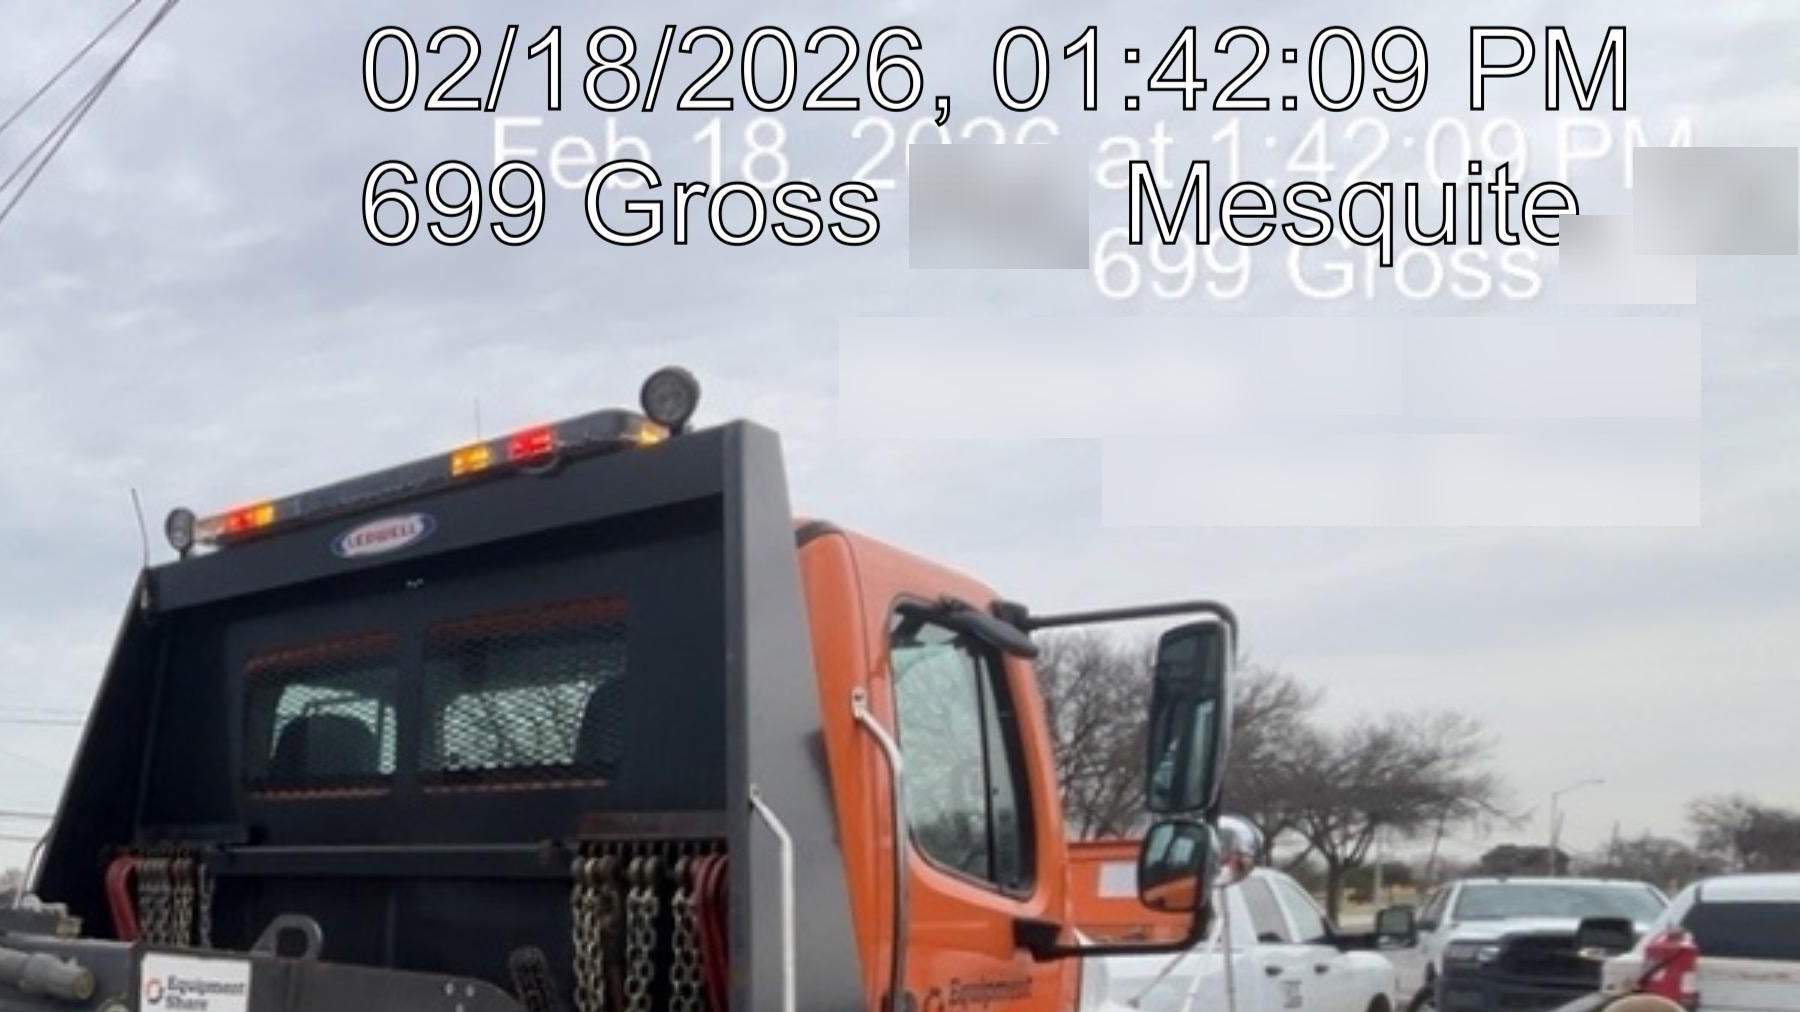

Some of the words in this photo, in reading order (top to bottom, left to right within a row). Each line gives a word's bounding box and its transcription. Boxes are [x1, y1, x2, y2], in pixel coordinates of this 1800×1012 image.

[347, 520, 416, 549] LEDWELL
[167, 974, 245, 996] Equipment
[165, 995, 209, 1012] Share
